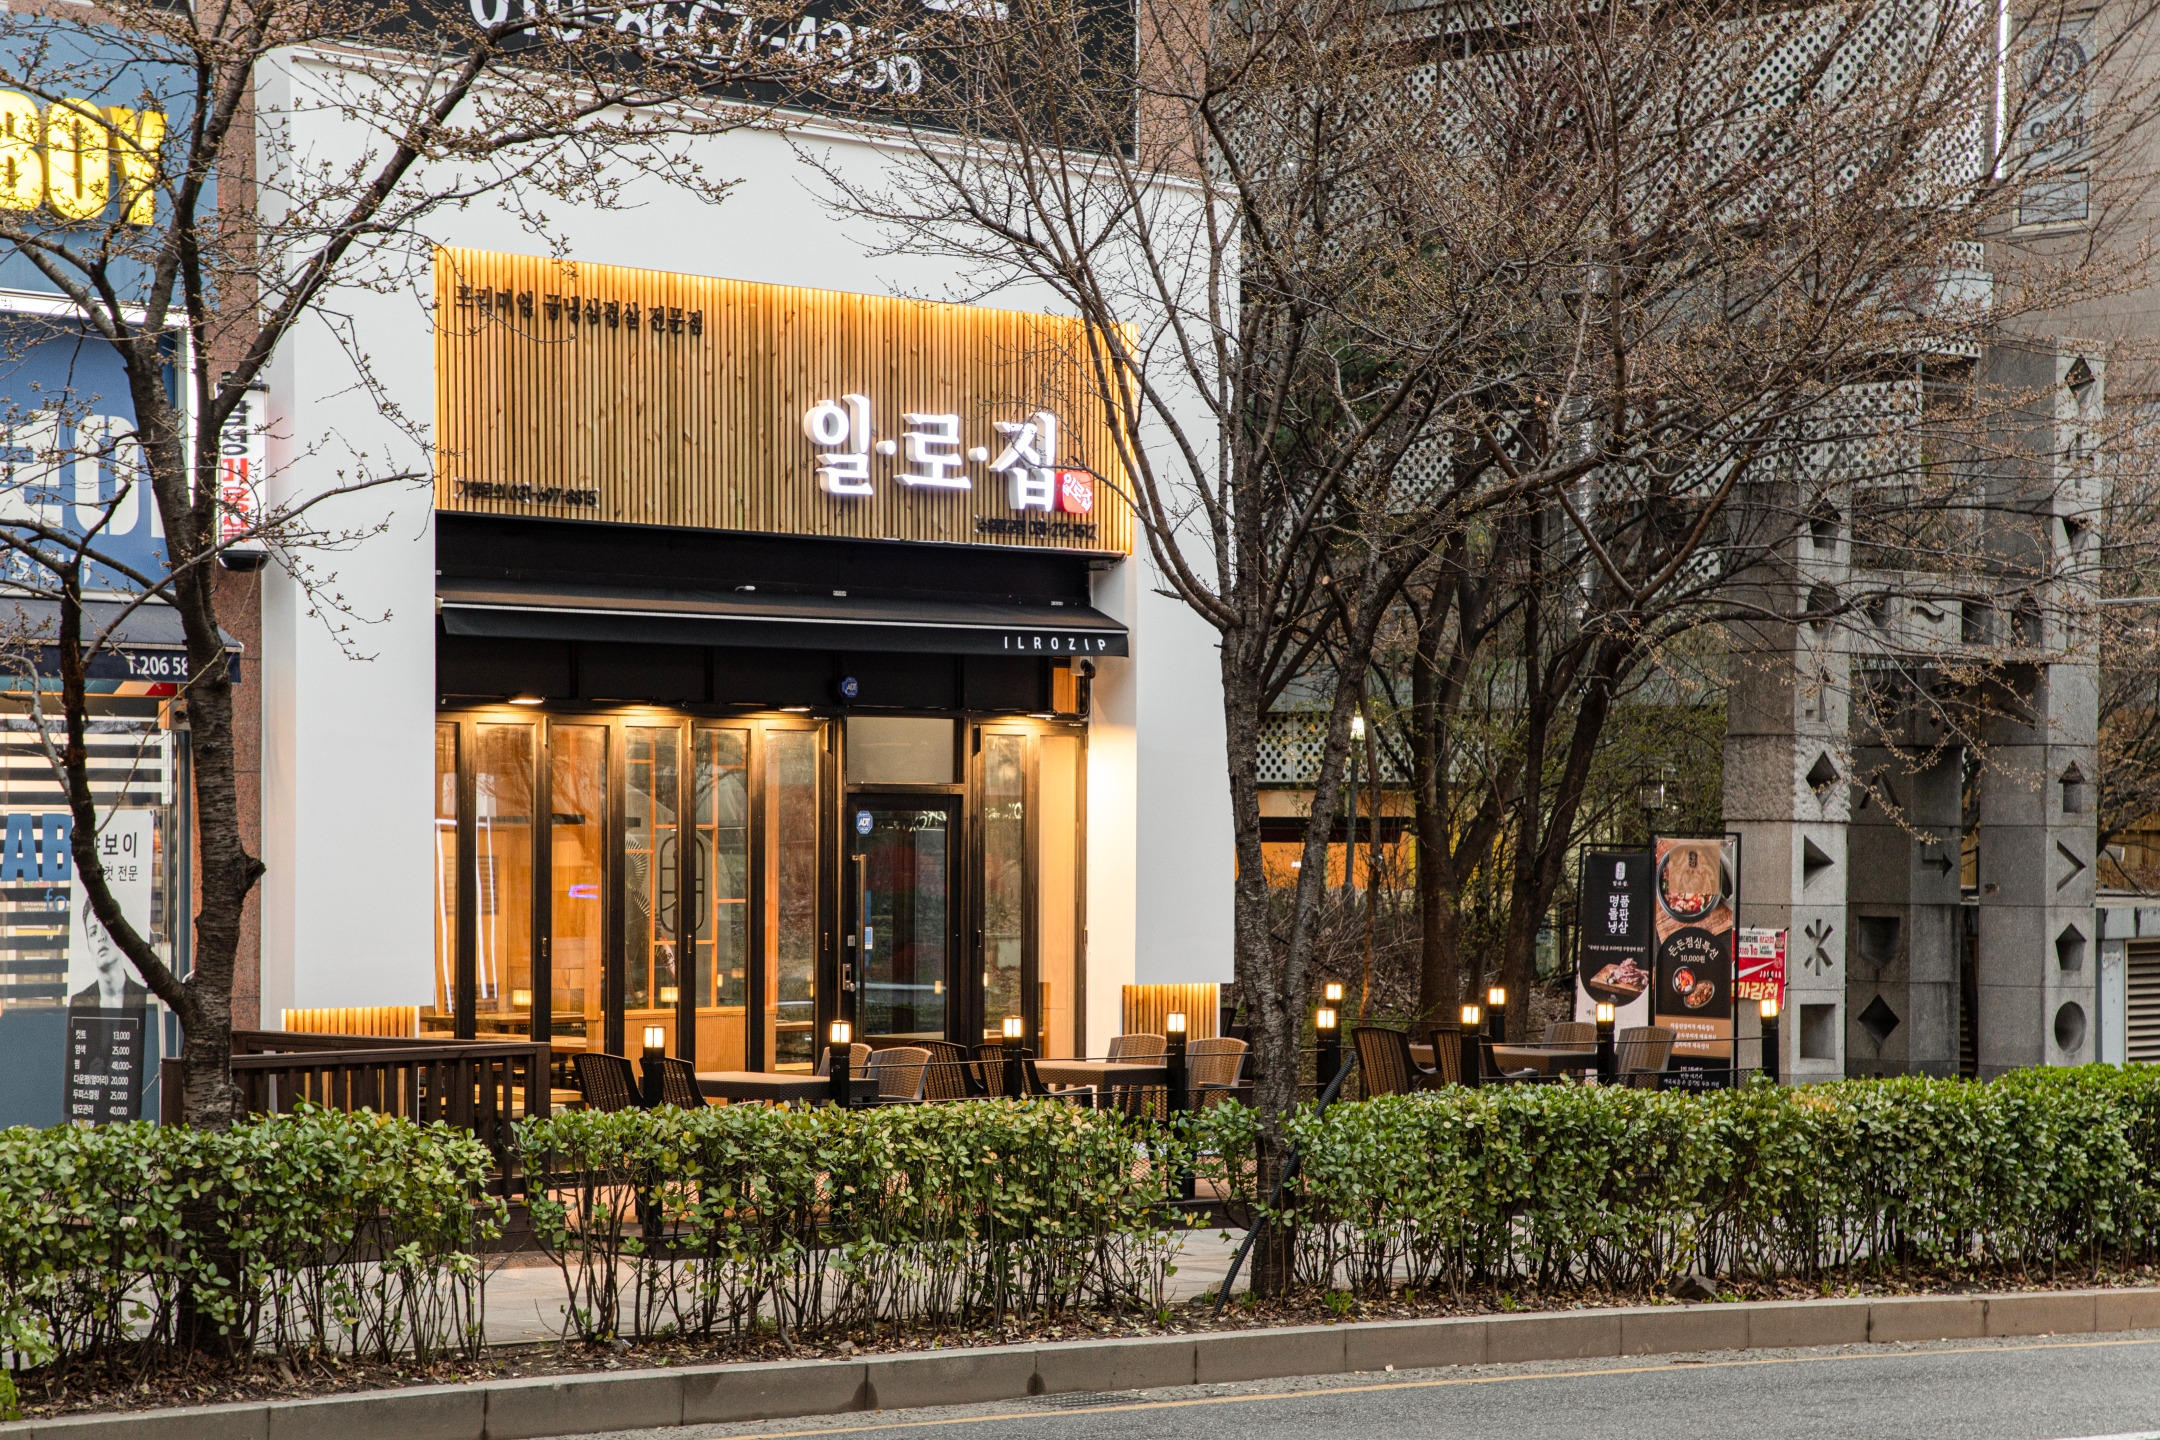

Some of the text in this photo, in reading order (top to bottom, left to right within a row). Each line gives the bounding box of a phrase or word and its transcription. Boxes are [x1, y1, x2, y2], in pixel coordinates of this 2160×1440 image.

[454, 285, 534, 318] 프리미엄
[648, 305, 703, 336] 전문점
[1004, 635, 1107, 651] ILROZIP
[858, 817, 871, 827] ADT
[118, 865, 138, 882] 전문
[1609, 895, 1630, 908] 명품
[1608, 908, 1630, 921] 돌판
[1608, 921, 1629, 934] 냉삼
[1668, 936, 1719, 961] 든든점심특선
[1680, 954, 1706, 963] 10,000원
[1732, 981, 1778, 1000] 마감전
[75, 1030, 131, 1040] 컷트 13,000
[74, 1045, 130, 1056] 염색 25,000
[110, 1076, 129, 1086] 20,000
[109, 1091, 128, 1100] 25,000
[109, 1106, 128, 1116] 40,000
